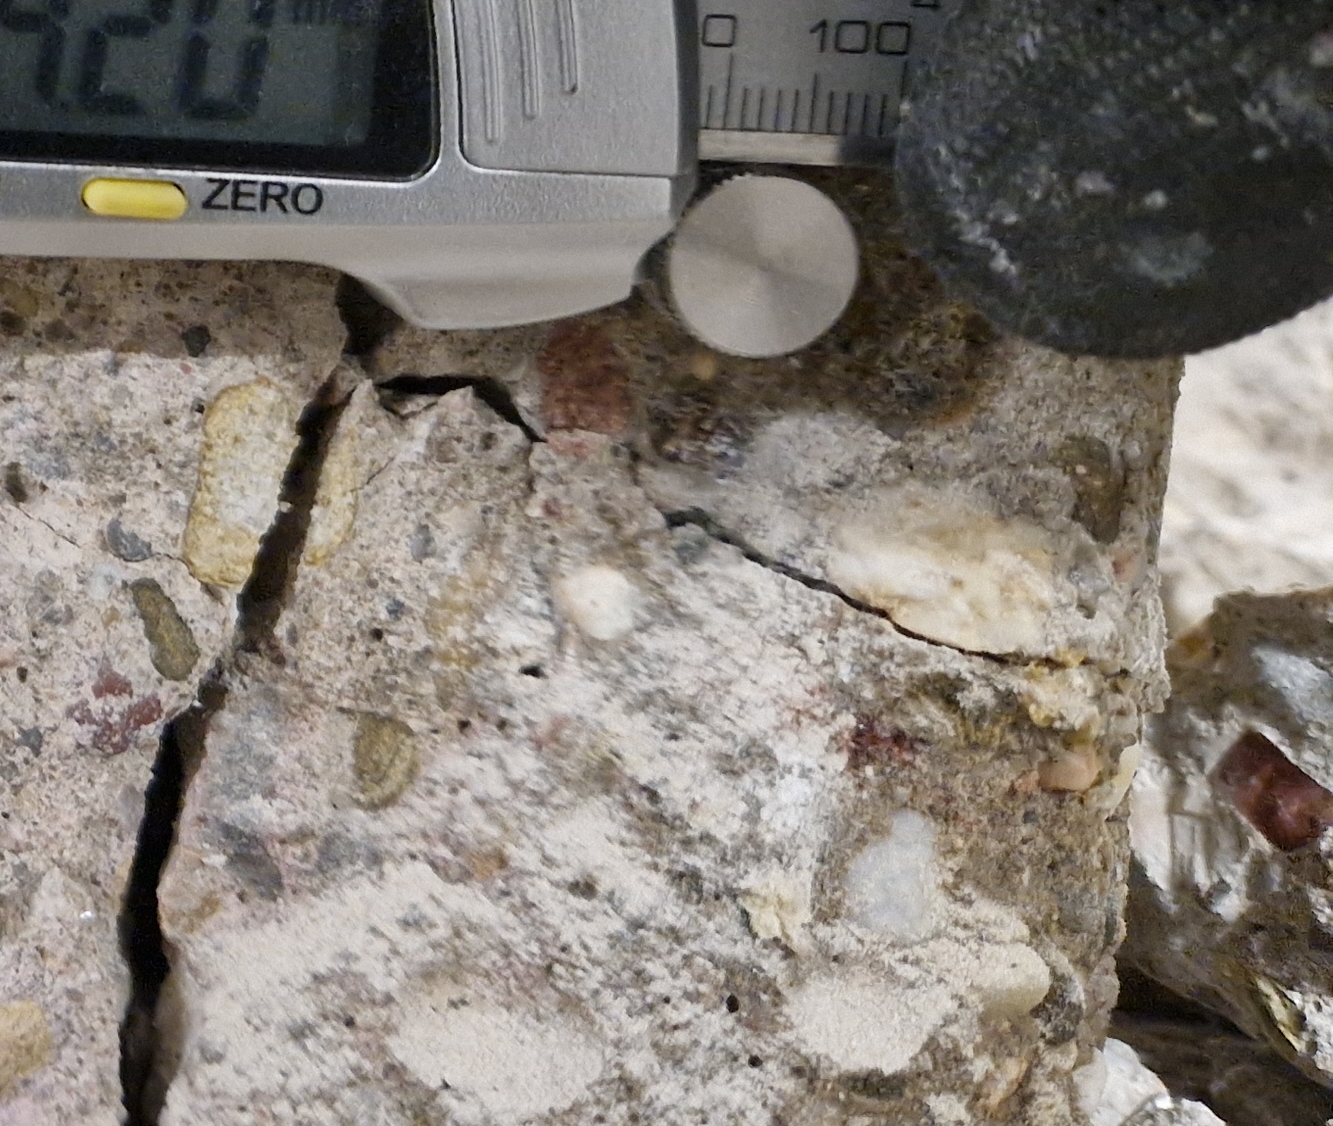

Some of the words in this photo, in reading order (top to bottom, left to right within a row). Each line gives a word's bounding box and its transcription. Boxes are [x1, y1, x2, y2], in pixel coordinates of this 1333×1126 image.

[701, 14, 737, 48] 0
[809, 19, 912, 56] 100
[200, 177, 325, 217] ZERO
